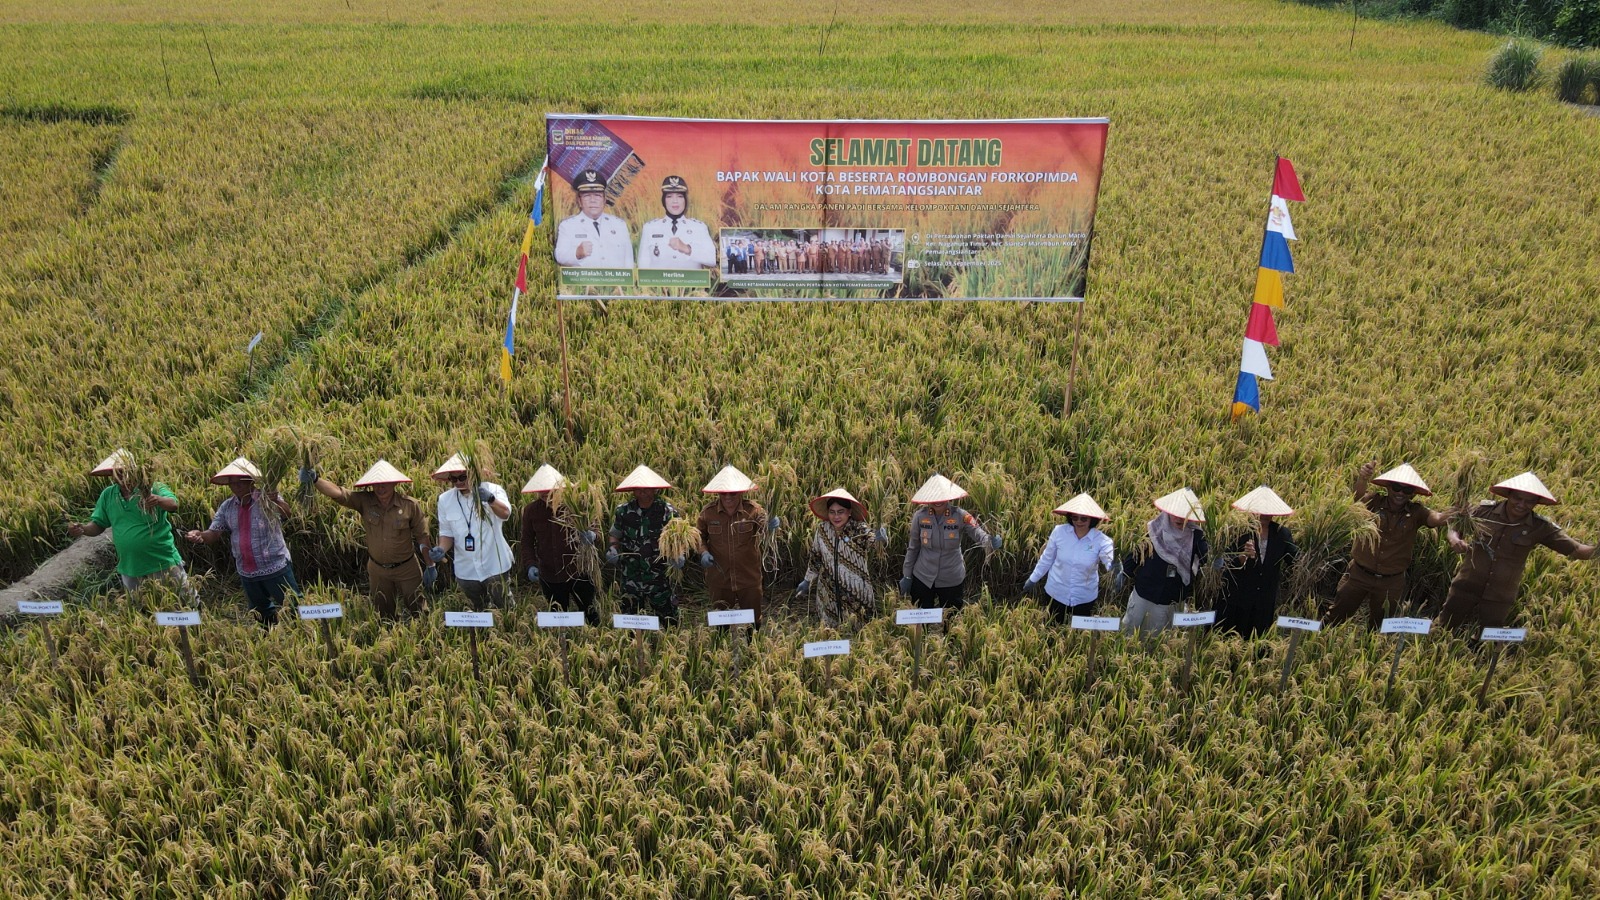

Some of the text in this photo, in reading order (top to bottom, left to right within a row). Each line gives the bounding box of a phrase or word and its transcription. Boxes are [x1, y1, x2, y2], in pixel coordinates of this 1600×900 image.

[809, 137, 1002, 168] SELAMAT DATANG
[717, 171, 1078, 183] BAPAK WALI KOTA BESERTA ROMBONGAN FORKOPIMDA
[815, 184, 982, 196] KOTA PEMATANGSIANTAR
